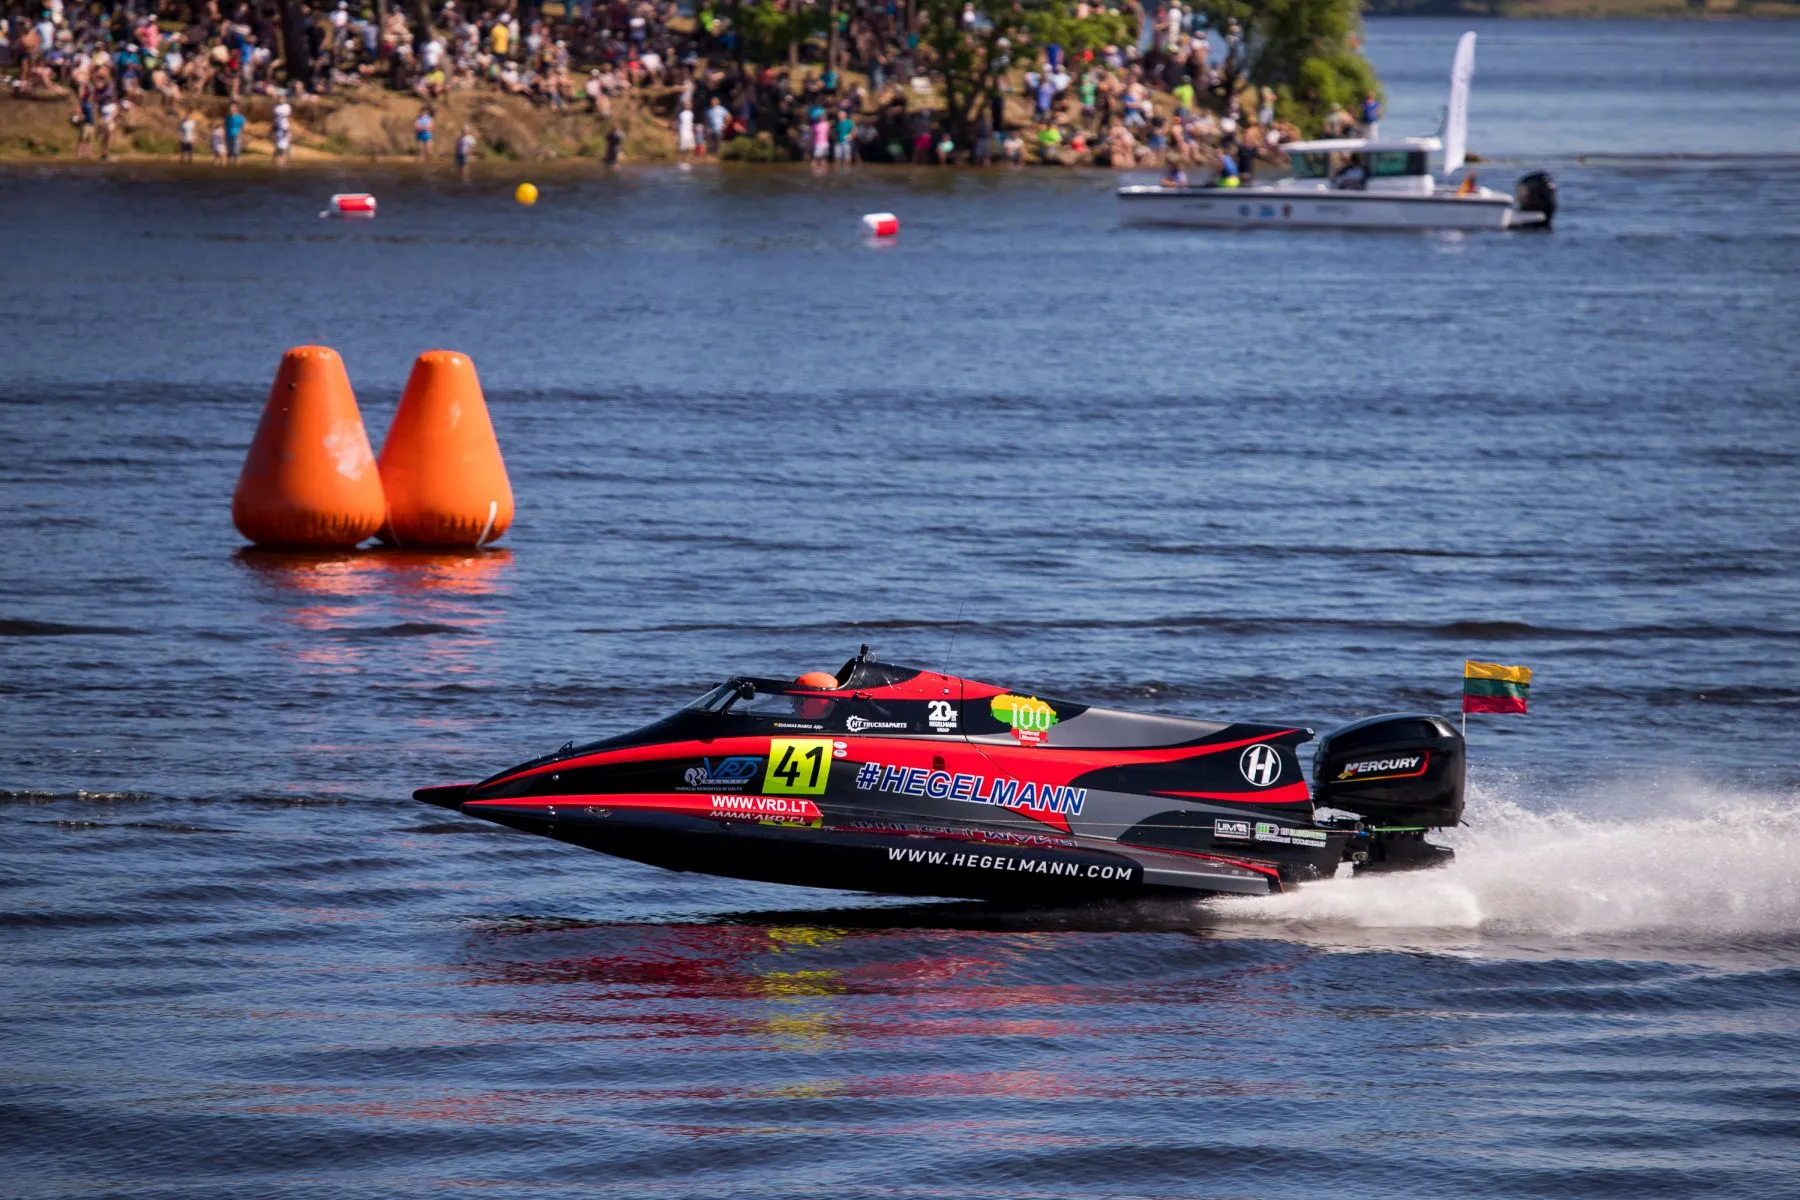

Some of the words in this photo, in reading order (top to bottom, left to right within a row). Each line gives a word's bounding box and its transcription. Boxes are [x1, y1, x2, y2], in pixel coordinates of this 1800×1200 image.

[927, 700, 952, 722] 20
[1011, 703, 1050, 732] 100
[851, 720, 862, 728] HT
[703, 756, 763, 780] VRD
[773, 745, 824, 788] 41
[1344, 756, 1420, 773] MERCURY
[856, 762, 1087, 816] #HEGELMANN
[711, 795, 809, 813] WWW.VRD.LT
[888, 848, 1132, 881] WWW.HEGELMANN.COM
